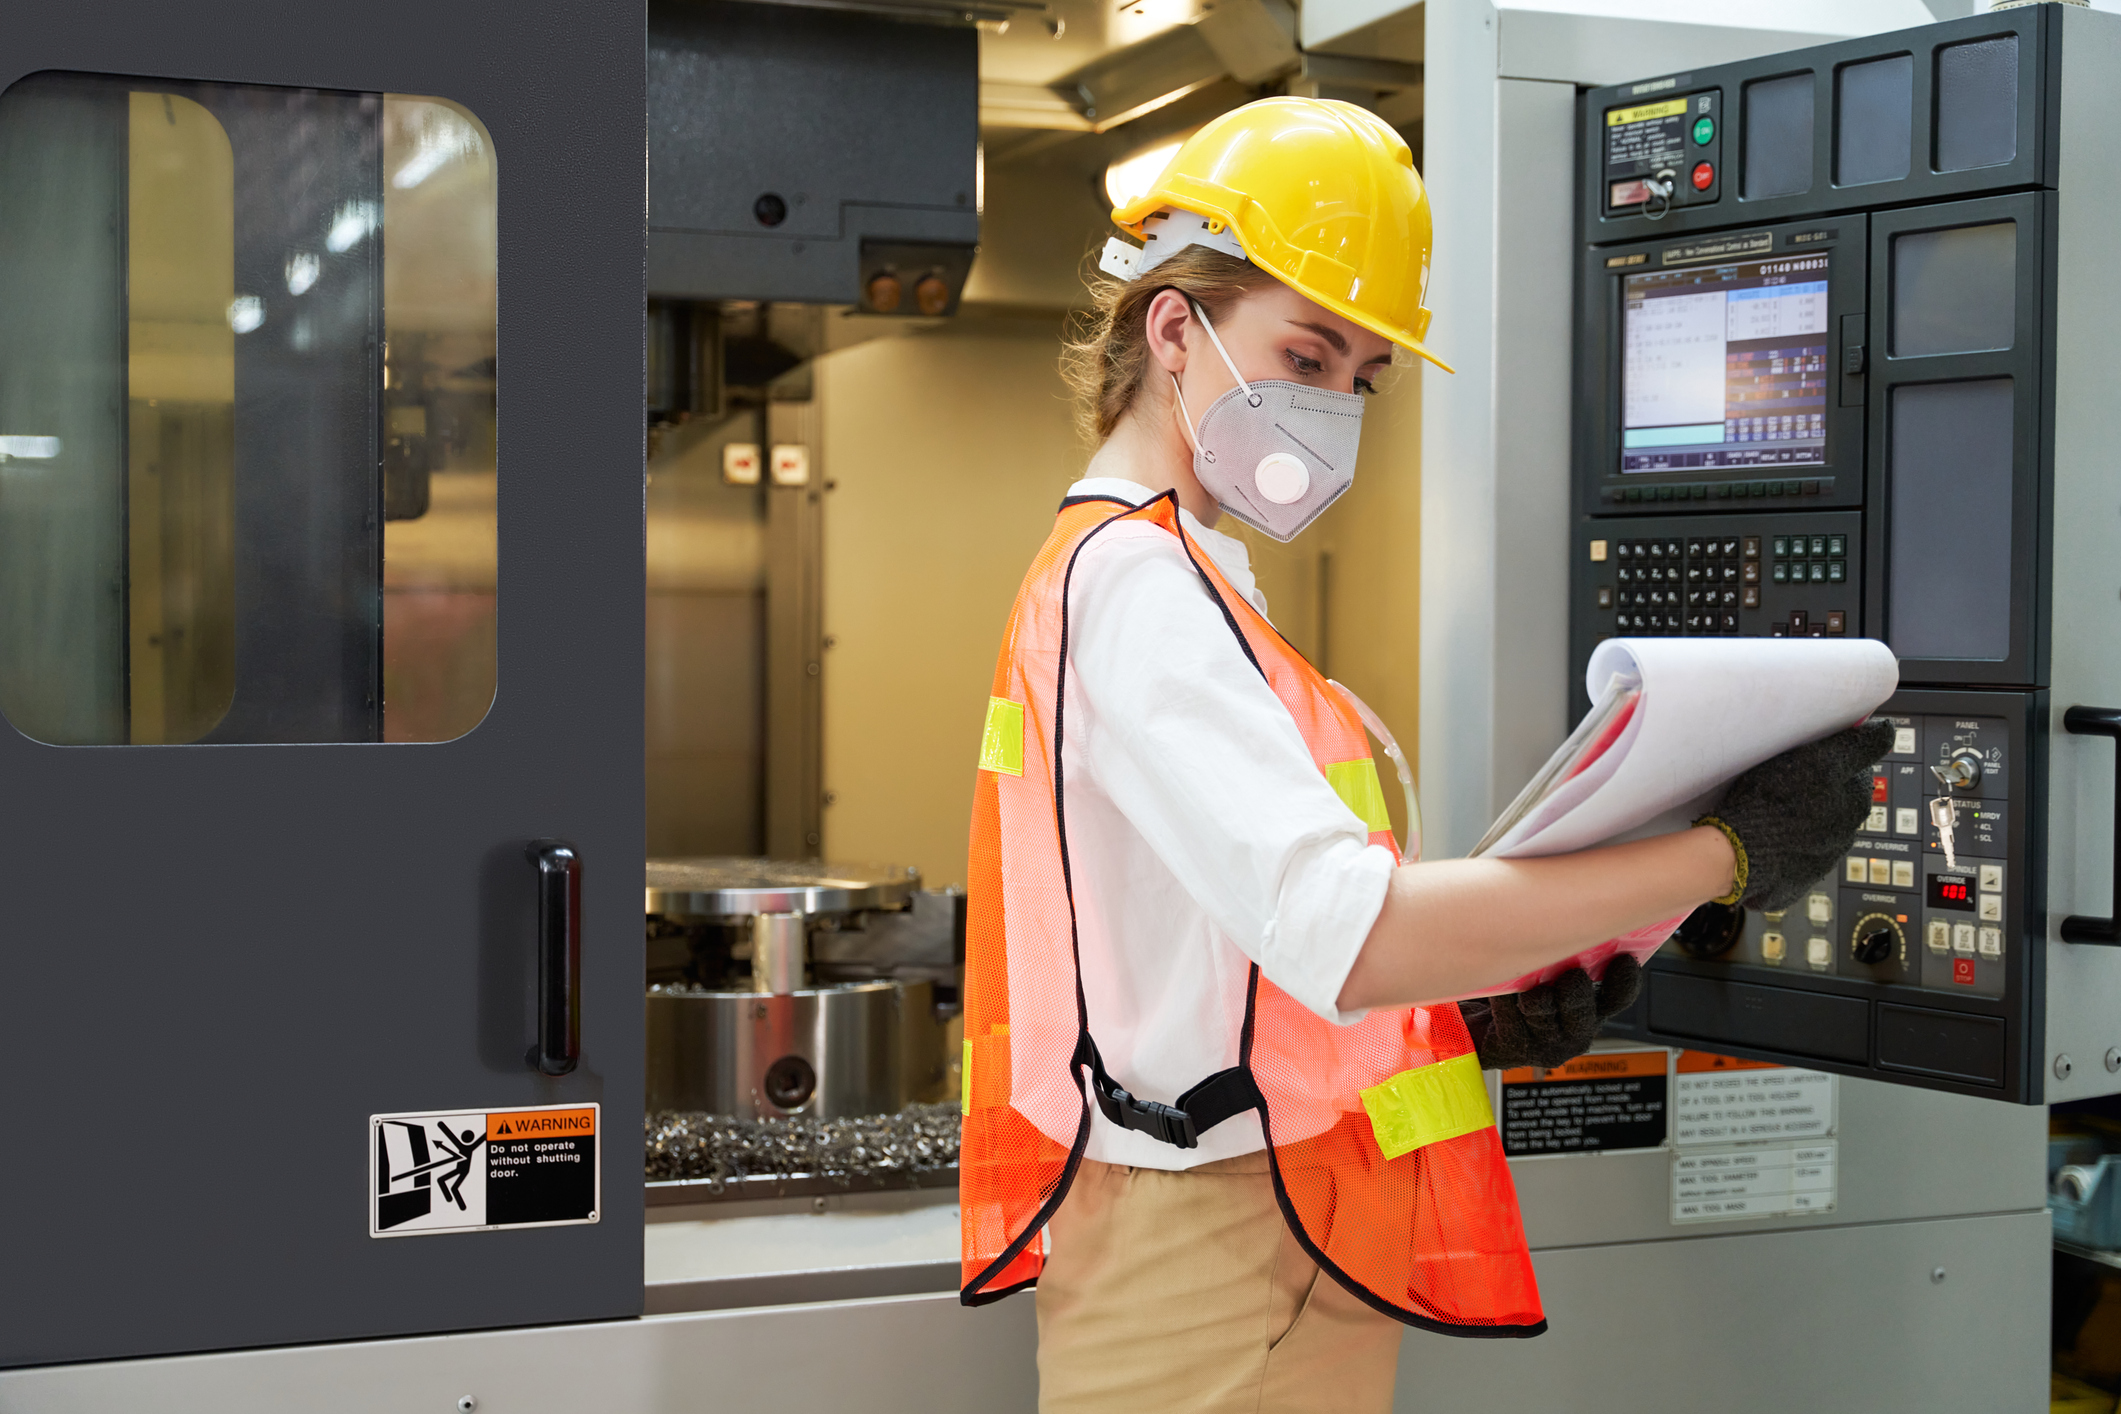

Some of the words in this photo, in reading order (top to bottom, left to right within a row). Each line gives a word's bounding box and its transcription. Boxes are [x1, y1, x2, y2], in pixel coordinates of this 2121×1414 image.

[1874, 842, 1909, 852] OVERRIDE
[1937, 875, 1966, 884] OVERRIDE
[1862, 893, 1896, 903] OVERRIDE
[1942, 885, 1966, 900] 100
[515, 1117, 590, 1132] WARNING
[490, 1145, 505, 1154] Do
[511, 1143, 528, 1153] not
[534, 1141, 575, 1152] operate
[490, 1154, 531, 1166] without
[536, 1153, 580, 1164] shutting
[490, 1168, 519, 1178] door.
